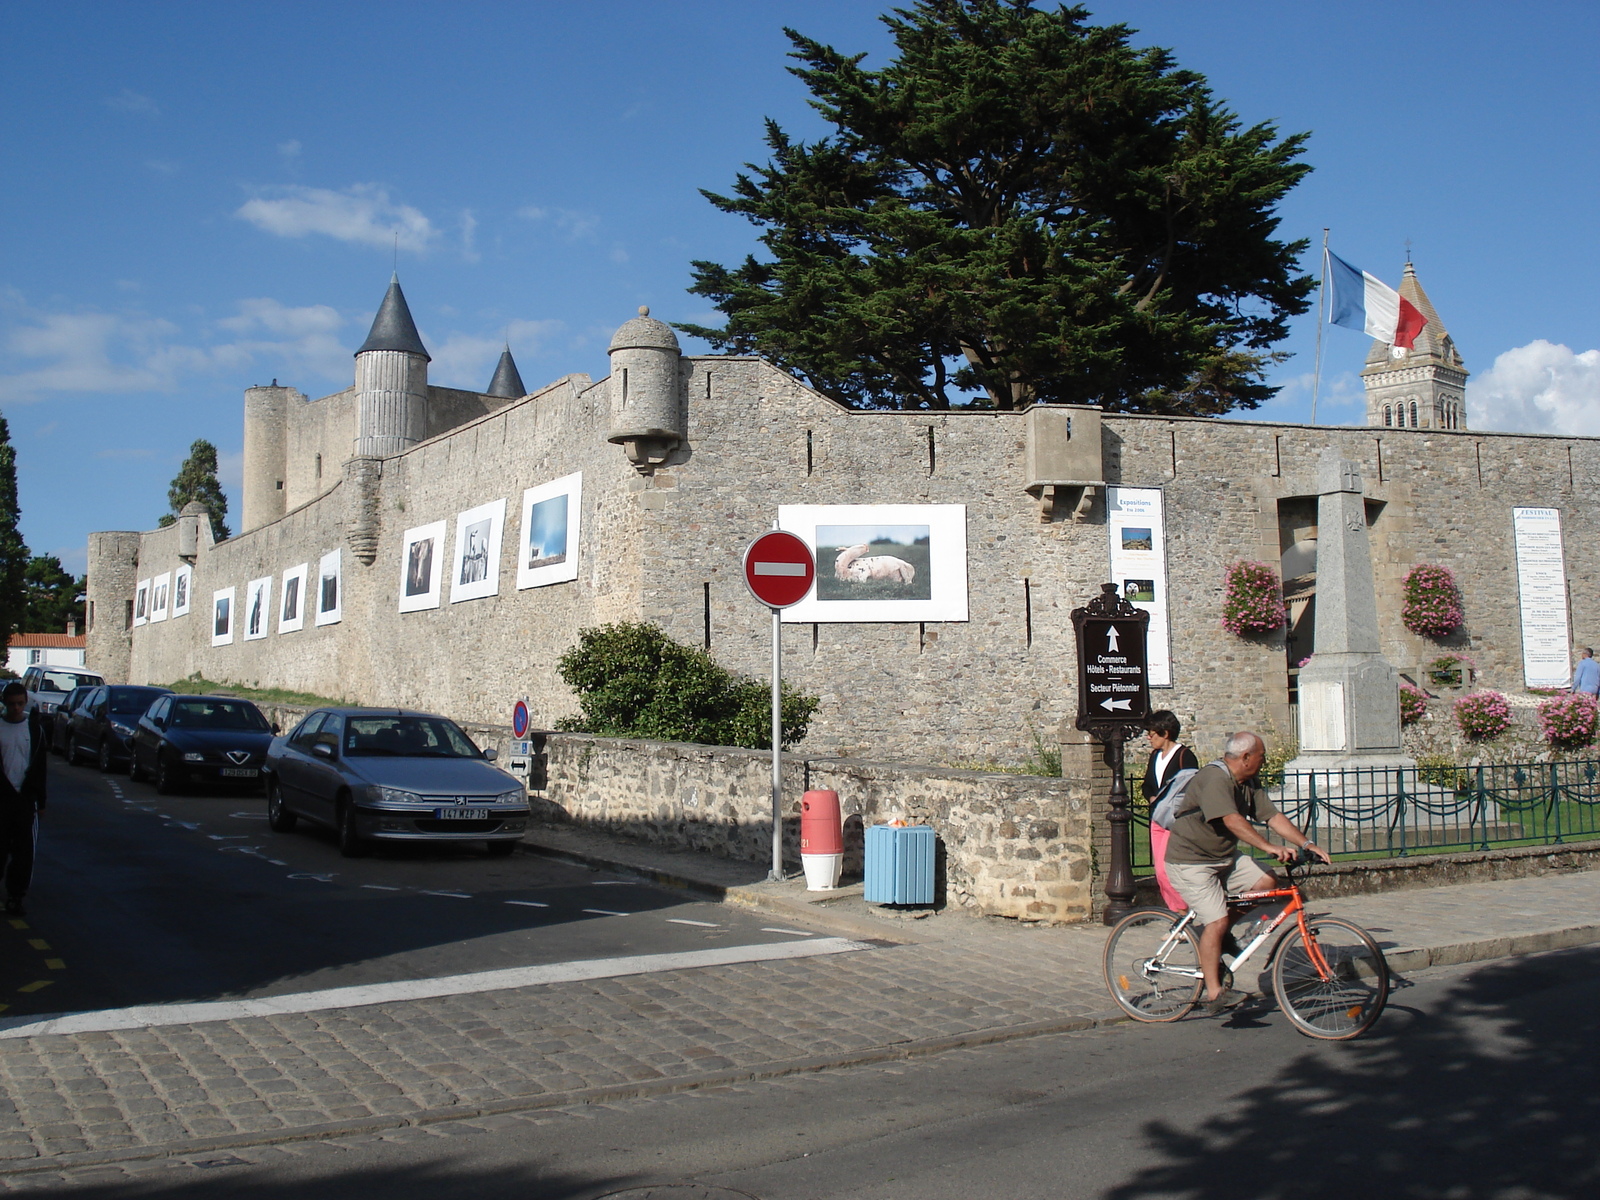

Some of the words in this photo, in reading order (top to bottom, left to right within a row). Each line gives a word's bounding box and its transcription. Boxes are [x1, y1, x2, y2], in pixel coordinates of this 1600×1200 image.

[1097, 655, 1127, 664] Commerce
[1087, 664, 1105, 674] Hôtels
[1108, 665, 1141, 674] Restaurants
[1090, 683, 1111, 692] Secteur
[1112, 683, 1140, 692] Piétonnier
[443, 809, 457, 819] 147
[477, 809, 486, 819] 75
